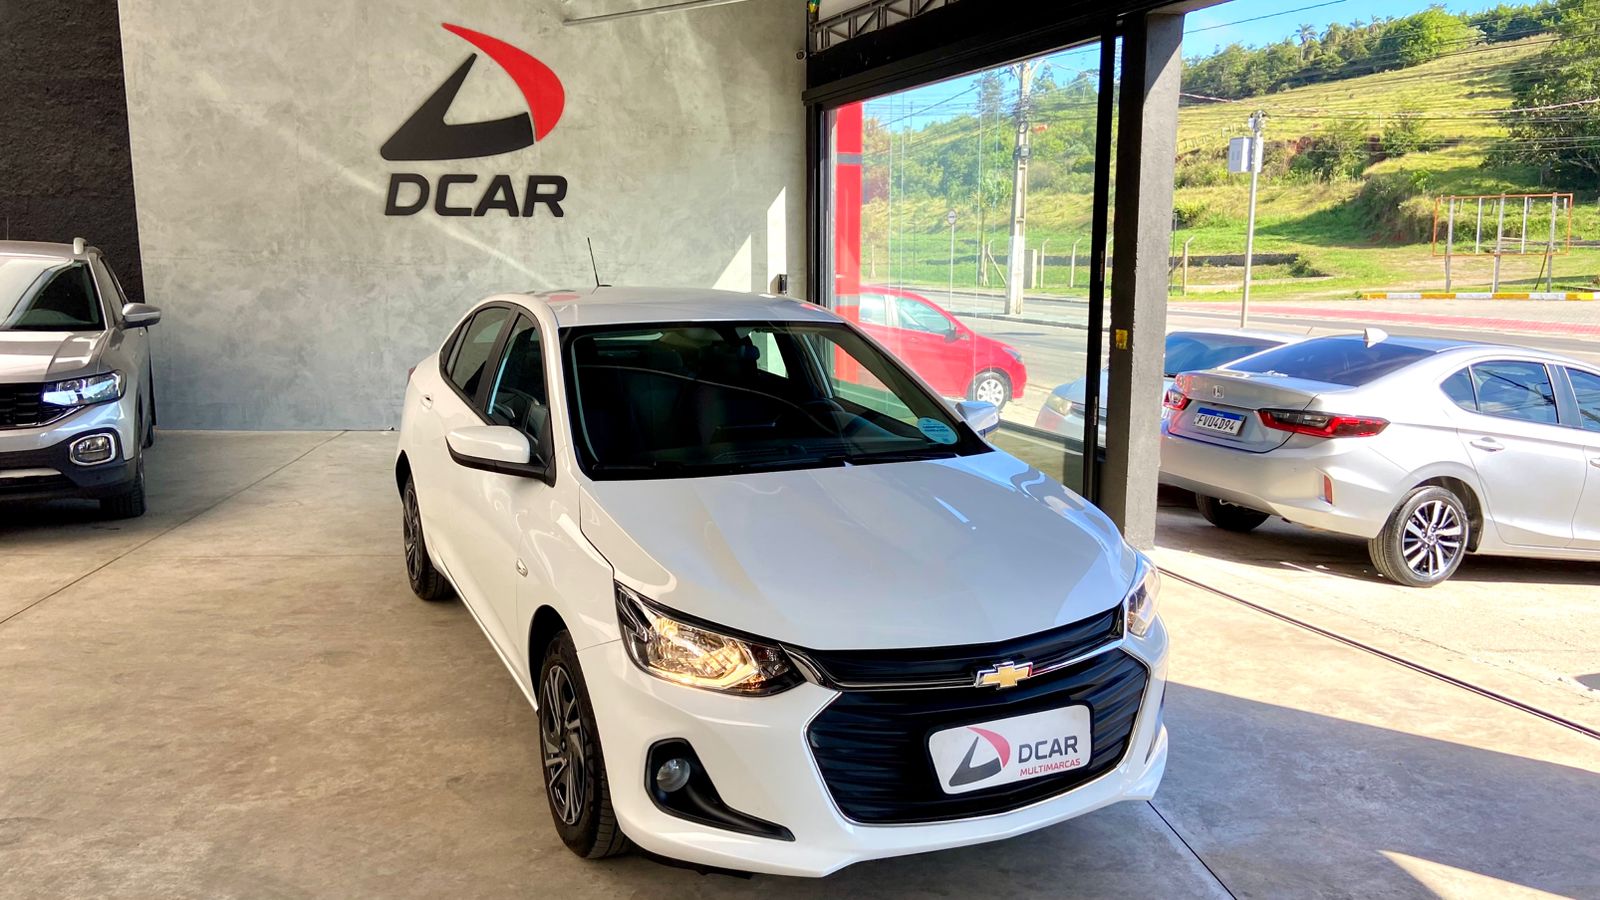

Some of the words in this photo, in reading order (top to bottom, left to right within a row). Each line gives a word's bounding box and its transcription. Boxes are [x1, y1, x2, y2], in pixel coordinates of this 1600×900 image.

[384, 173, 568, 217] DCAR
[1018, 735, 1078, 763] DCAR
[1019, 758, 1081, 776] MULTIMARCAS
